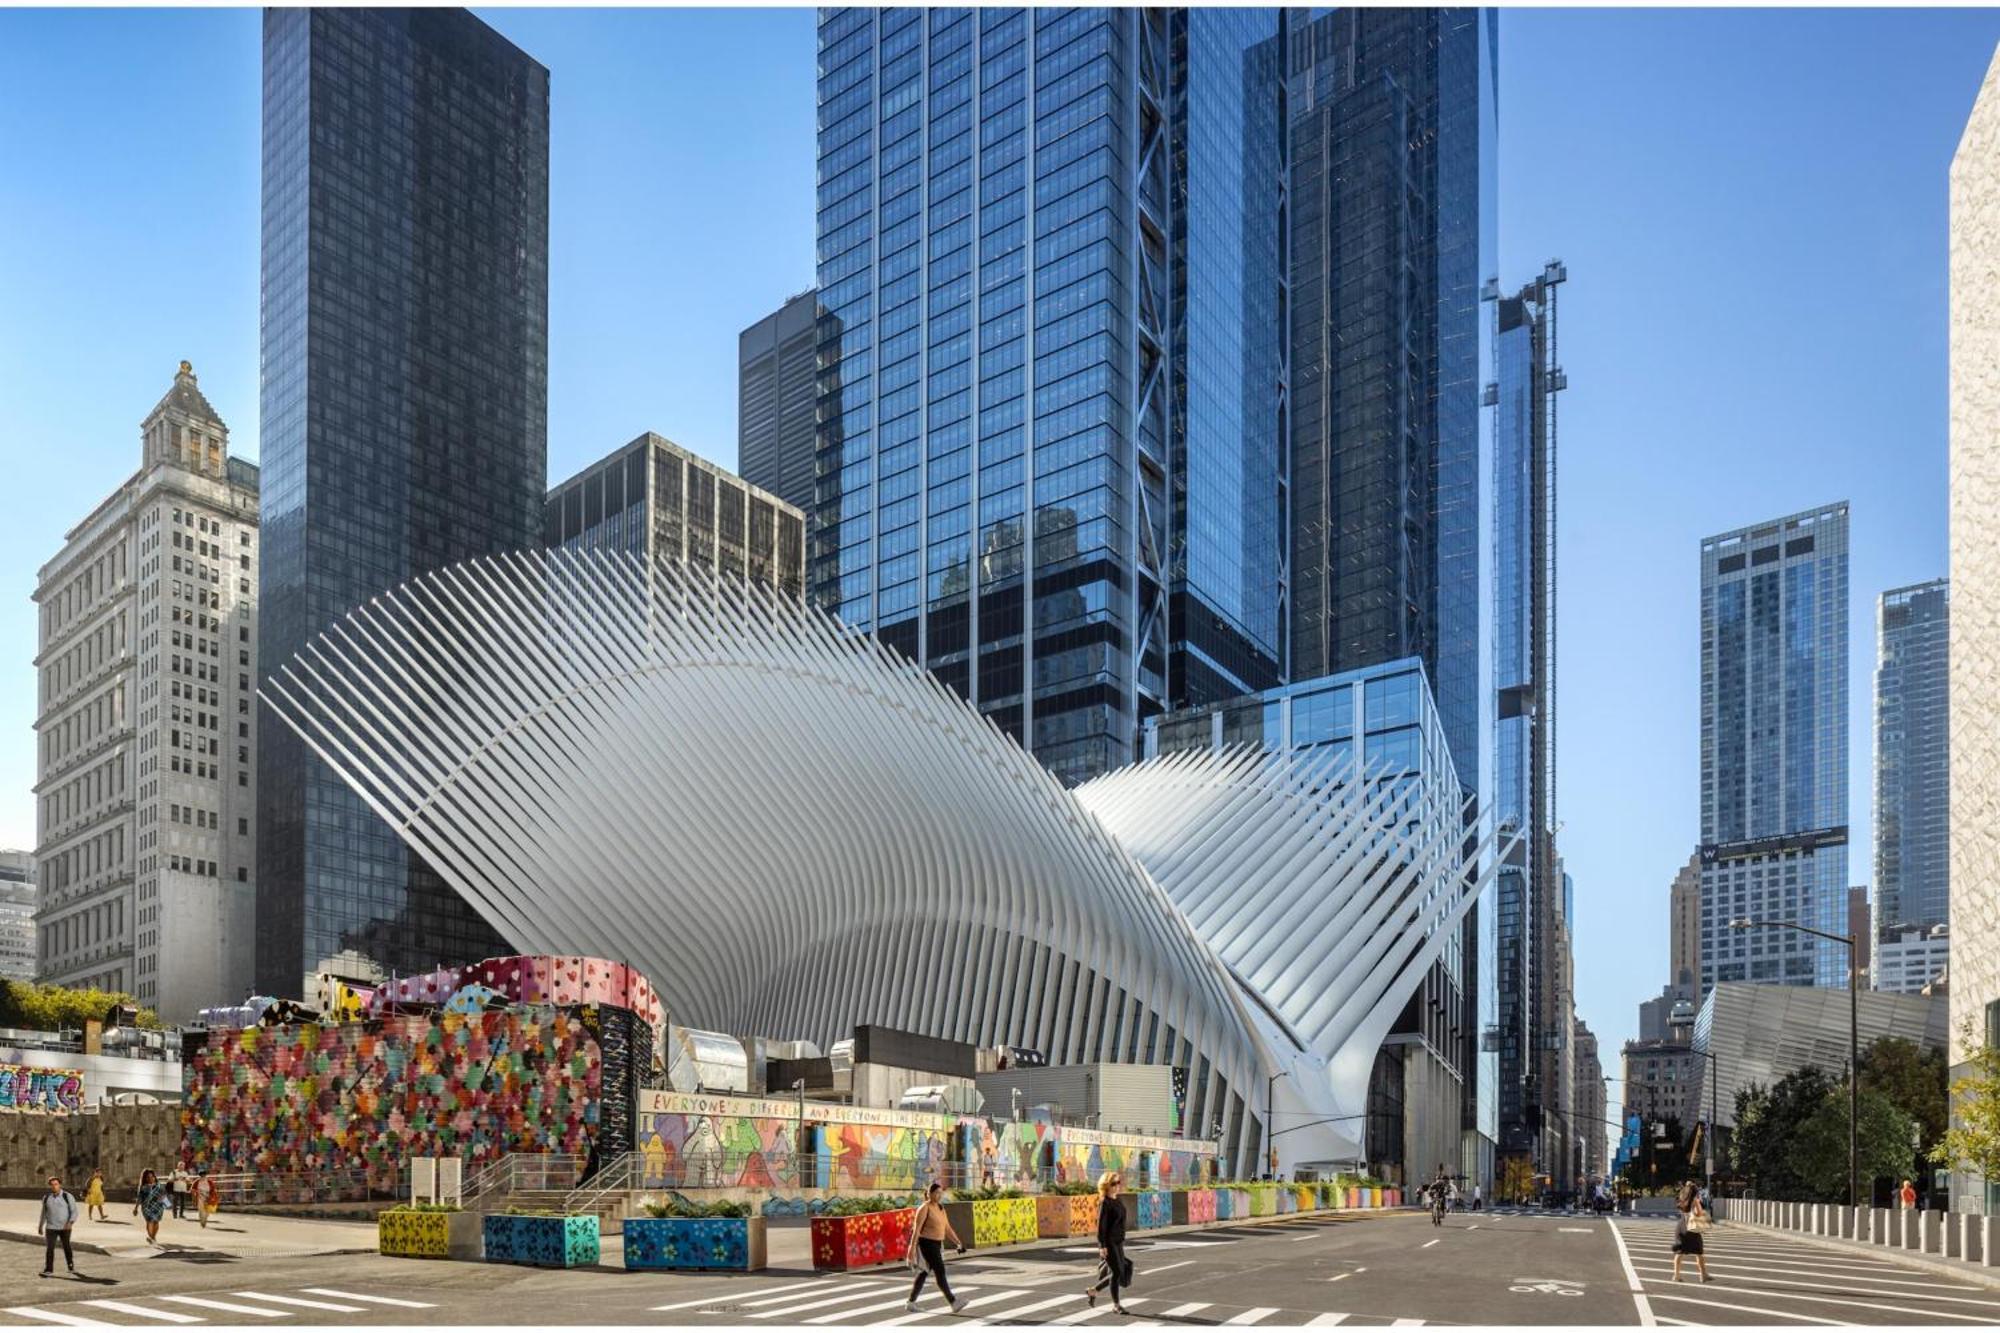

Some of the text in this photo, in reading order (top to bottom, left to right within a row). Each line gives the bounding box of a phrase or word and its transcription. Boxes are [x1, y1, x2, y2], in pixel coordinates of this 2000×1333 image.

[1703, 849, 1716, 859] W
[653, 1093, 740, 1114] EVERYONE'S
[750, 1101, 801, 1117] DIFFEREN
[809, 1108, 830, 1118] AND
